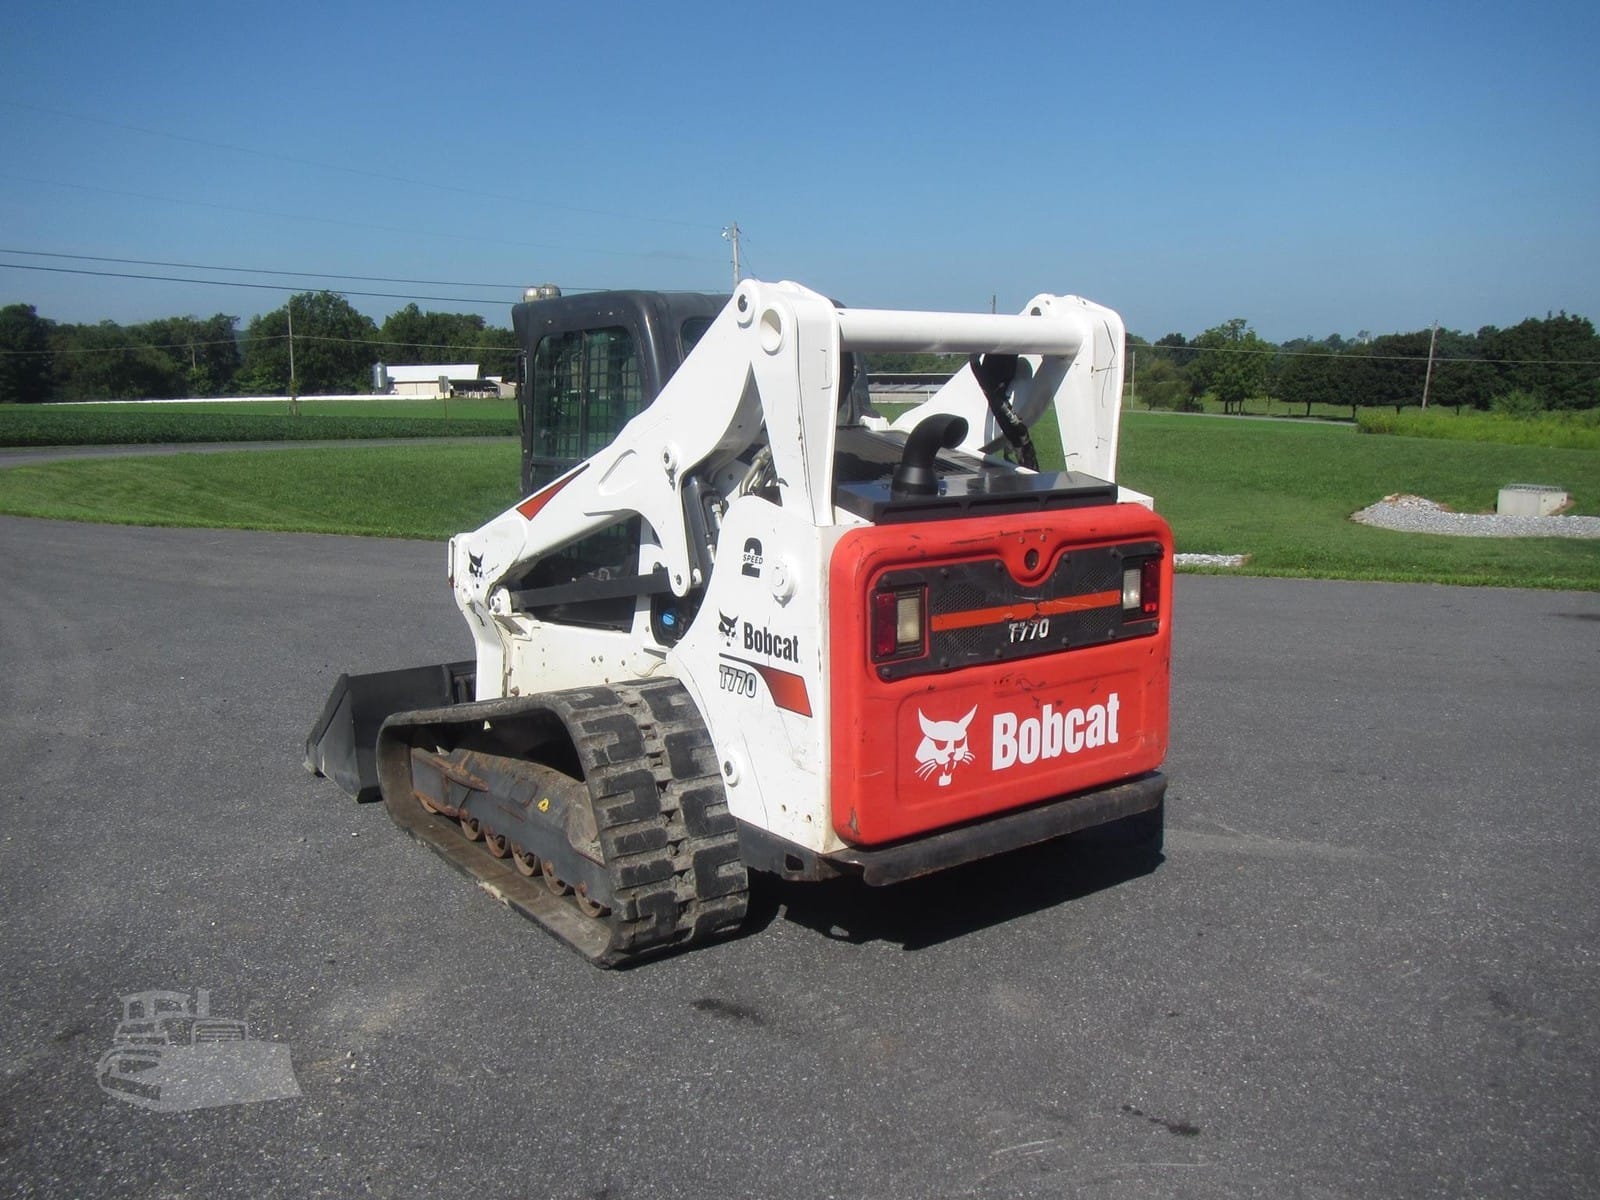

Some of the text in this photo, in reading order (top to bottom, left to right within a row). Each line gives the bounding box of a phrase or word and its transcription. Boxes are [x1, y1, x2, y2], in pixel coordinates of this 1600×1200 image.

[742, 537, 763, 578] 2
[742, 554, 764, 565] SPEED
[743, 621, 799, 663] Bobcat
[1008, 618, 1050, 643] T770
[719, 664, 757, 698] T770
[992, 692, 1120, 771] Bobcat
